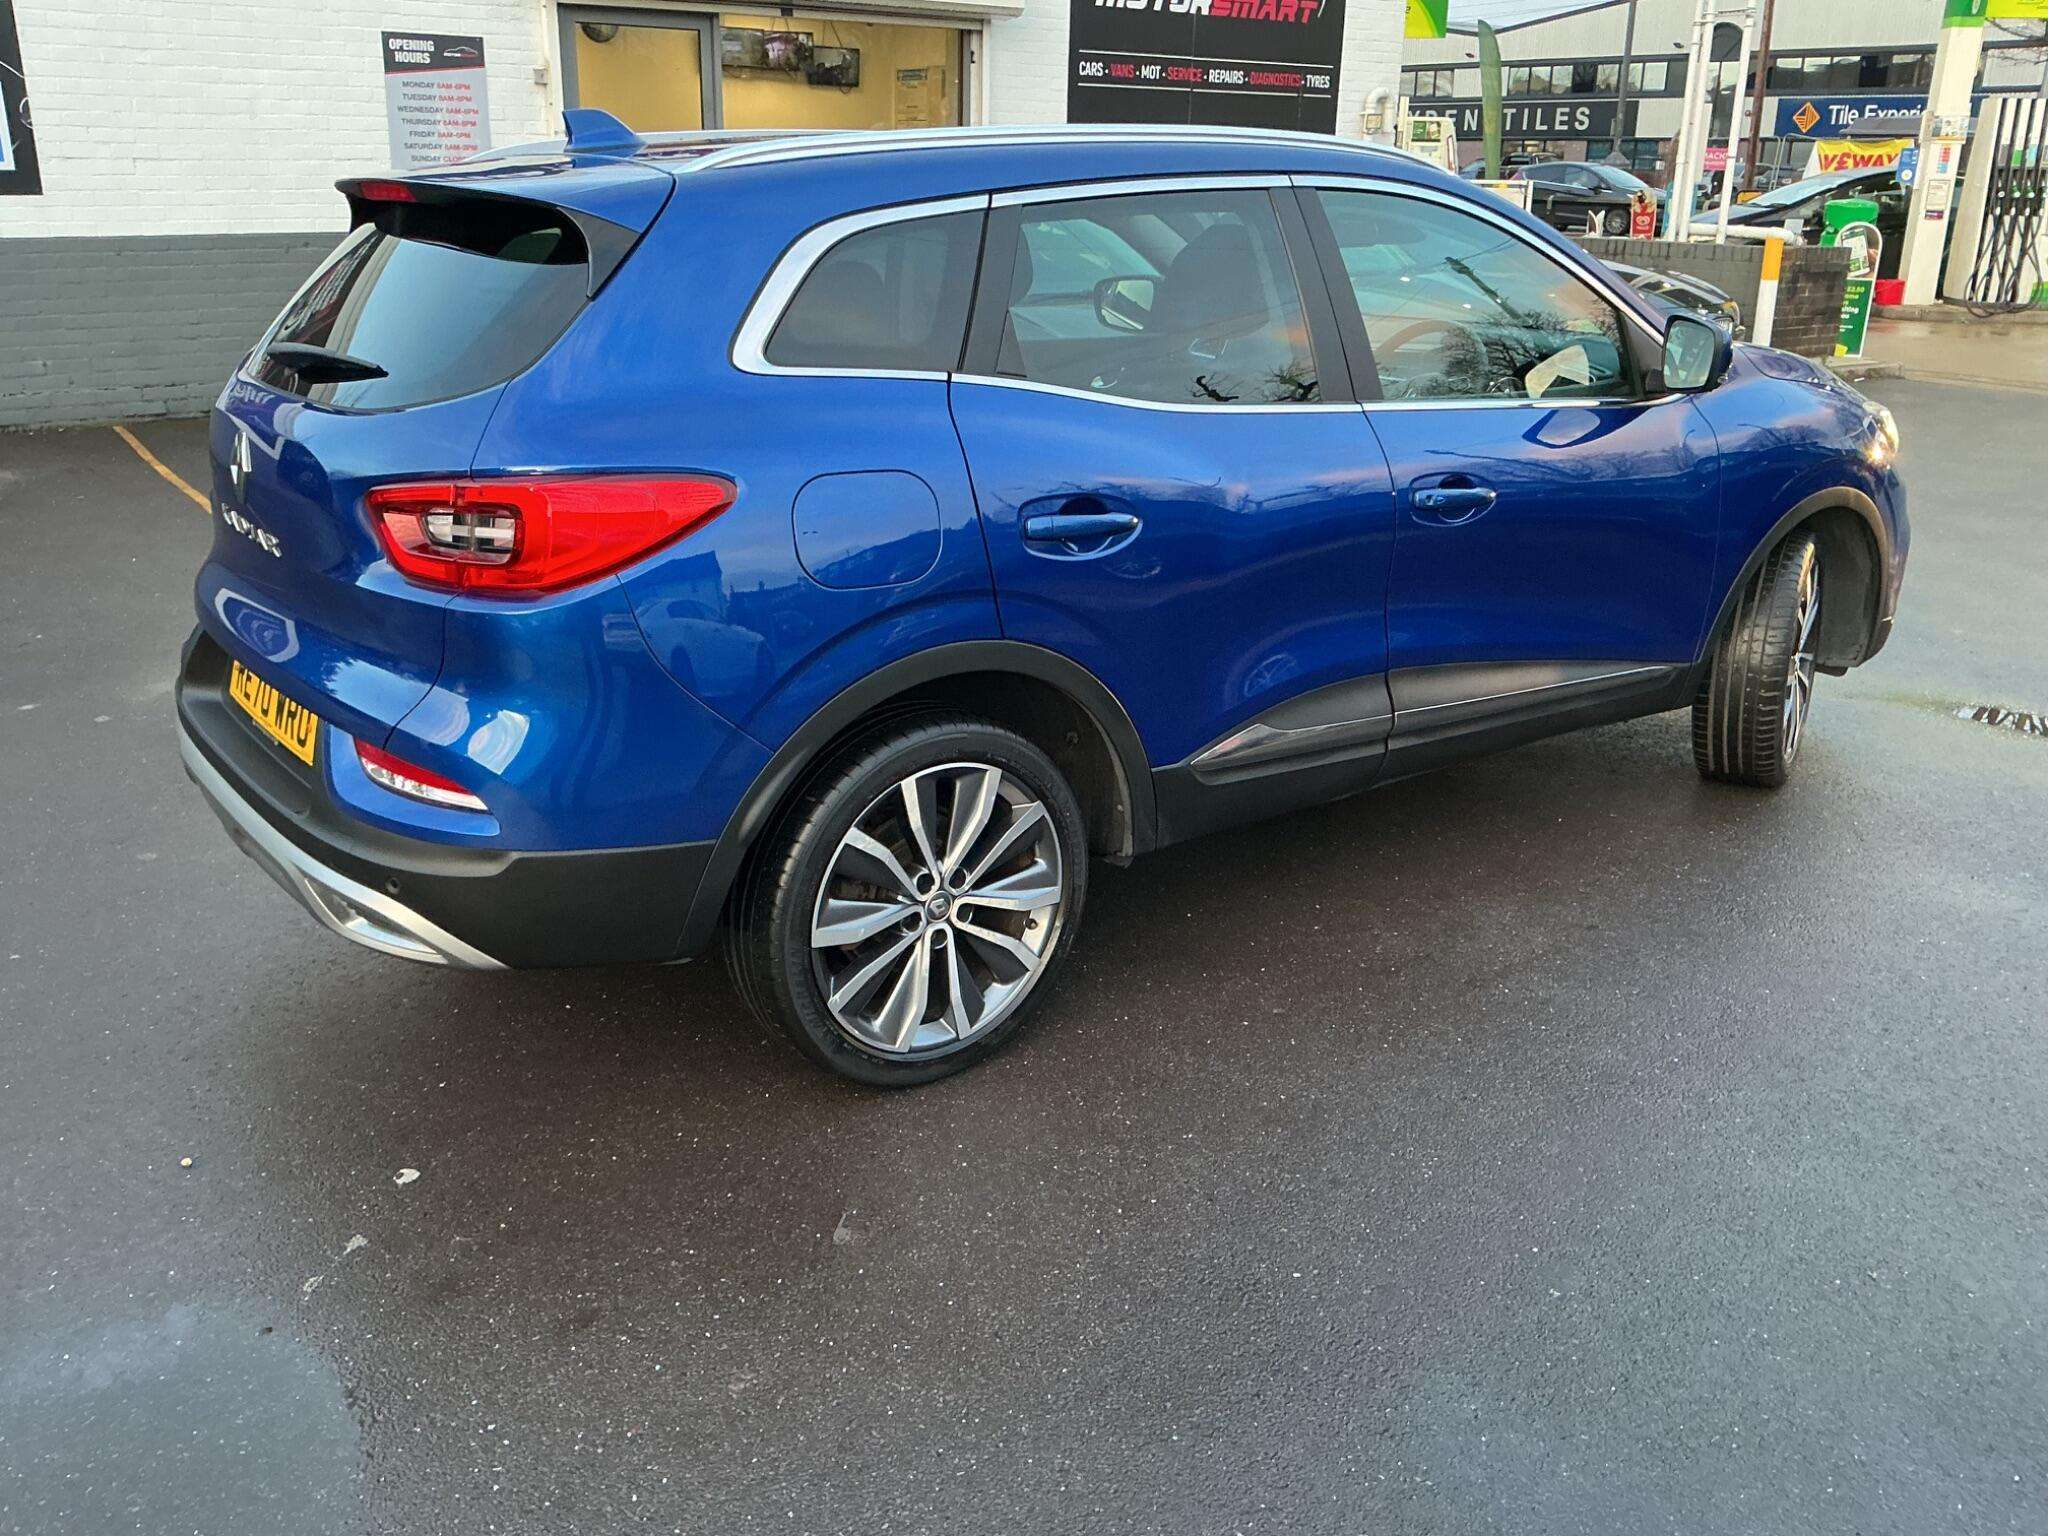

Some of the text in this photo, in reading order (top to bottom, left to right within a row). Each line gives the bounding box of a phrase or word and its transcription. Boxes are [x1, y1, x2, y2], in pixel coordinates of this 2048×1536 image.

[1094, 0, 1319, 23] ORSMART
[388, 38, 434, 52] OPENING
[394, 51, 431, 64] HOURS
[1079, 61, 1331, 89] CARS VANS MOT SERVICE REPAIRS DIAGNOSTICS TYRES
[402, 81, 434, 89] MONDAY
[402, 93, 437, 101] TUESDAY
[397, 106, 443, 114] WEDNESDAY
[1828, 104, 1859, 125] Tile
[401, 118, 441, 126] THURSDAY
[1502, 106, 1591, 132] TILES
[404, 143, 442, 151] SATURDAY
[274, 691, 312, 749] WRU
